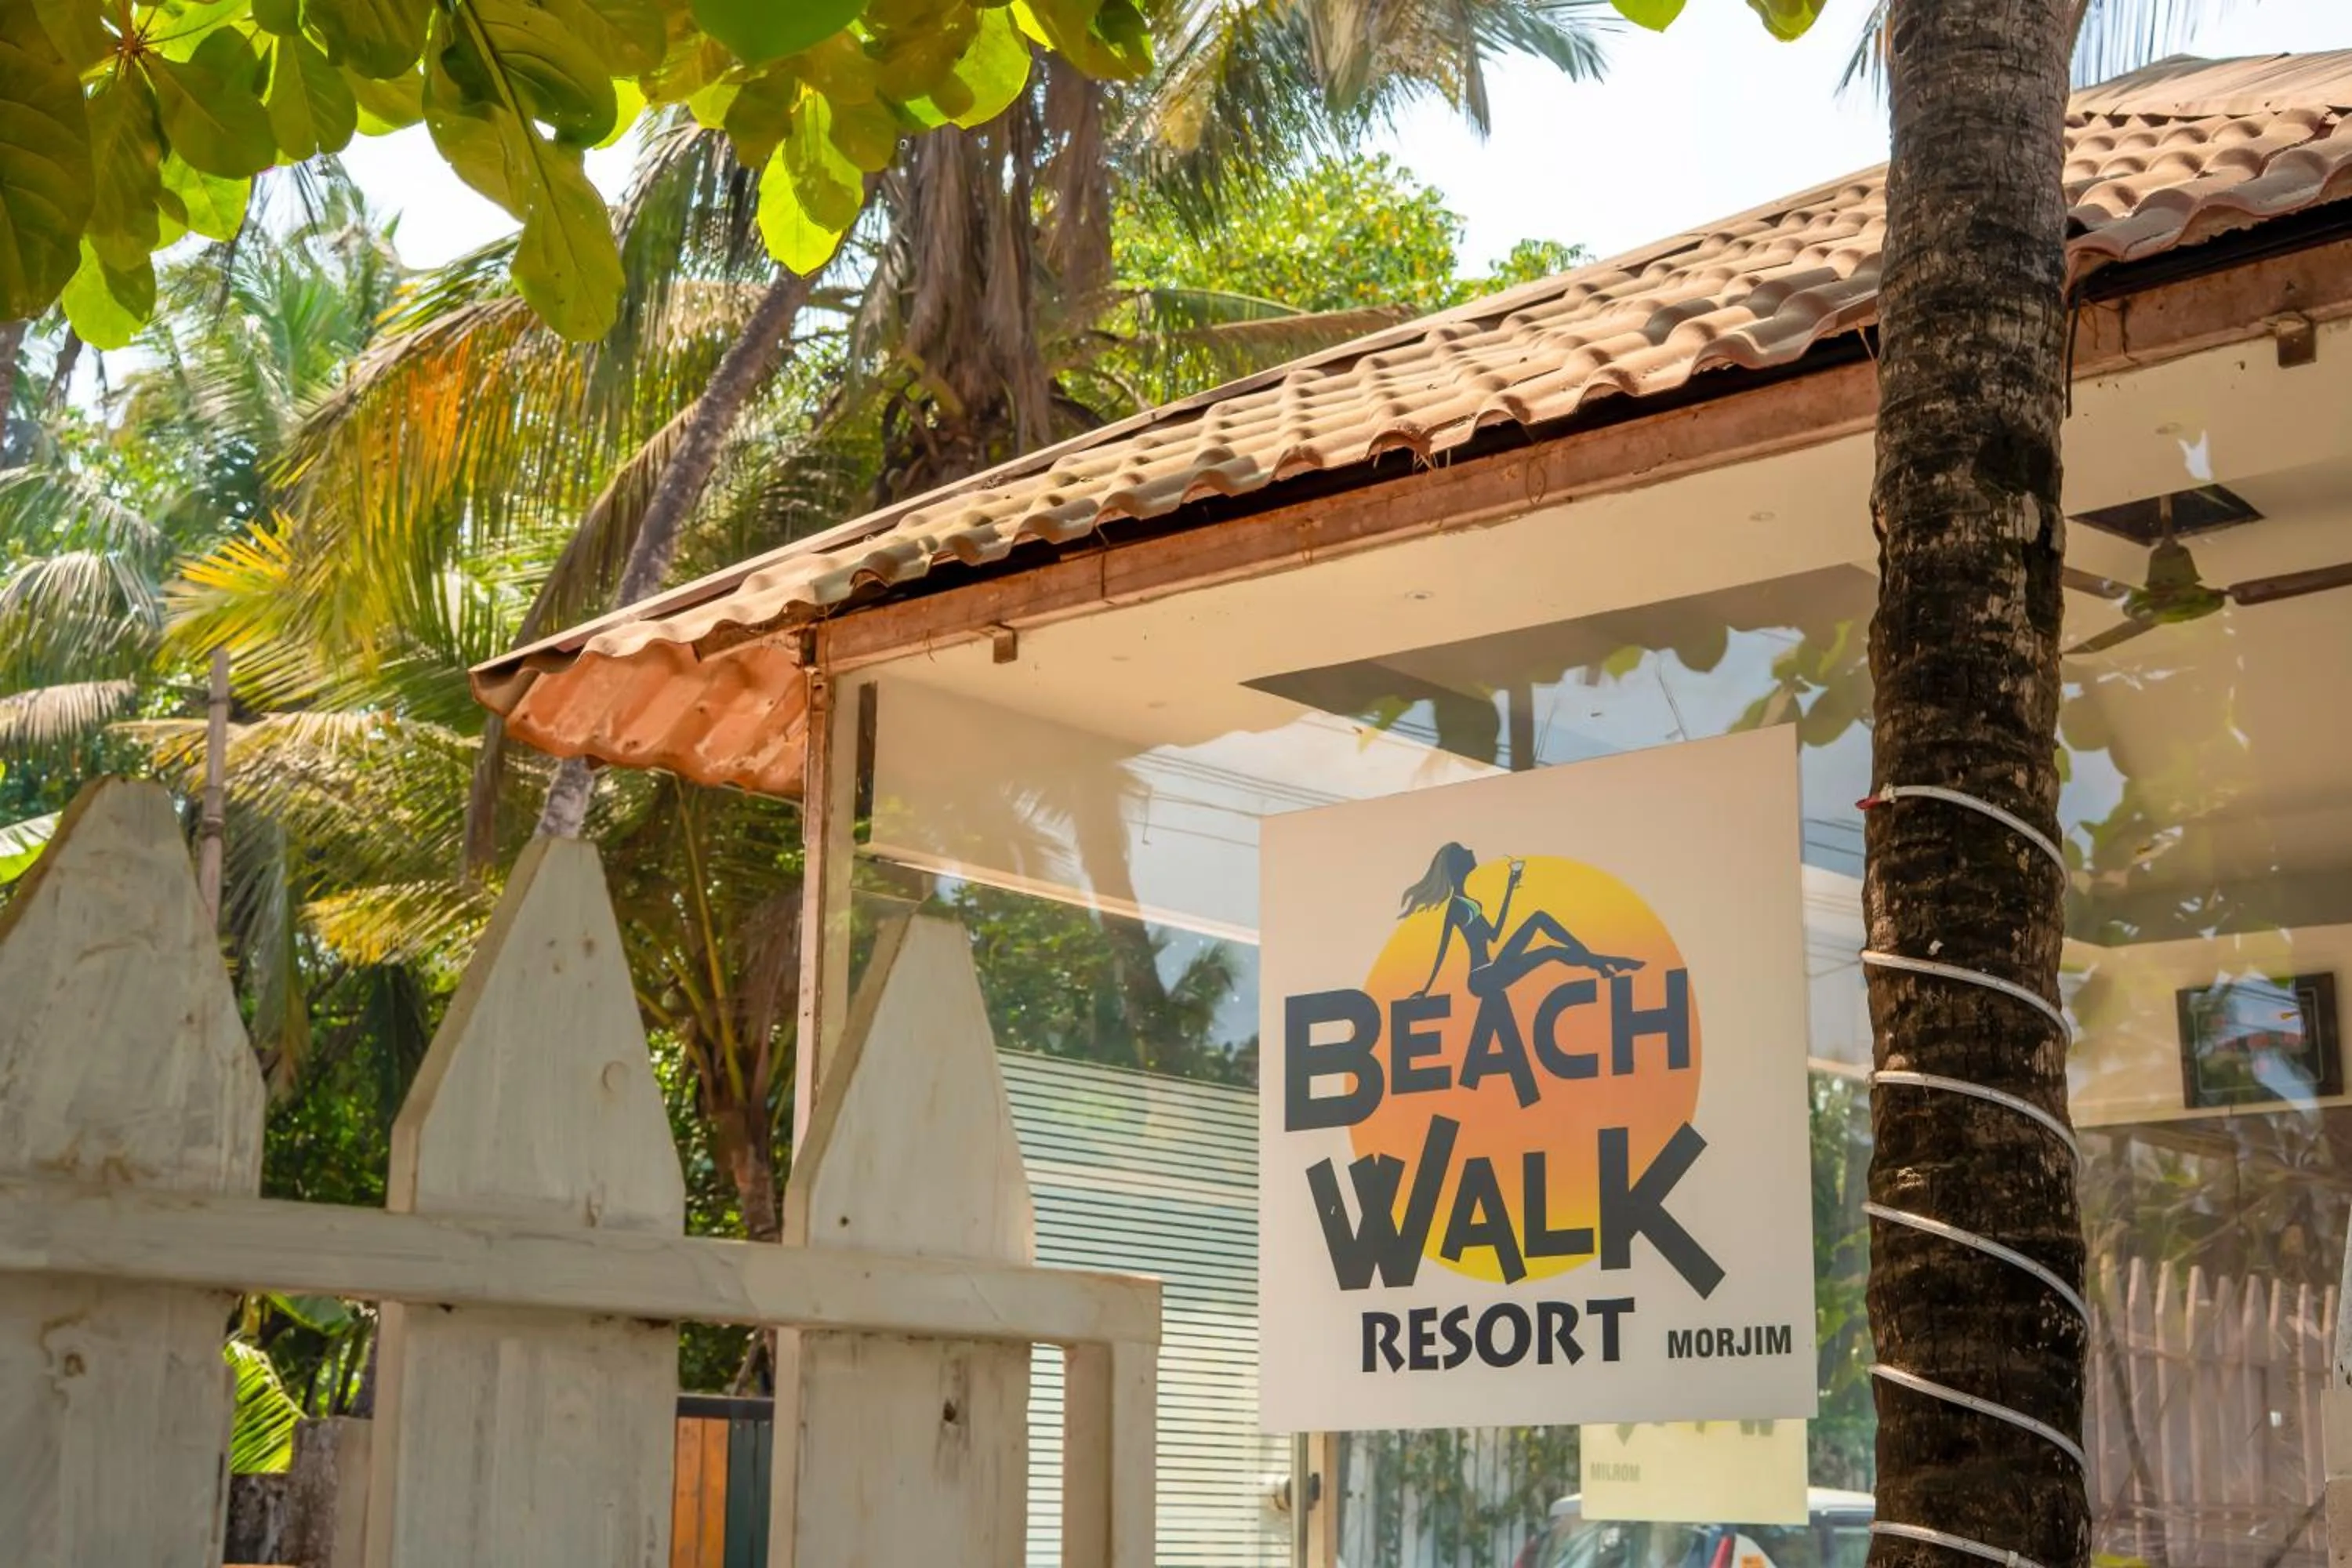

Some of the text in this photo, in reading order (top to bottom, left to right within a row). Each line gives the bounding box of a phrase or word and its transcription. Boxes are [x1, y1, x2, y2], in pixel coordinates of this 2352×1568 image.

[1284, 967, 1690, 1132] BEACH
[1305, 1113, 1726, 1300] WALK
[1361, 1297, 1635, 1373] RESORT
[1667, 1325, 1792, 1359] MORJIM
